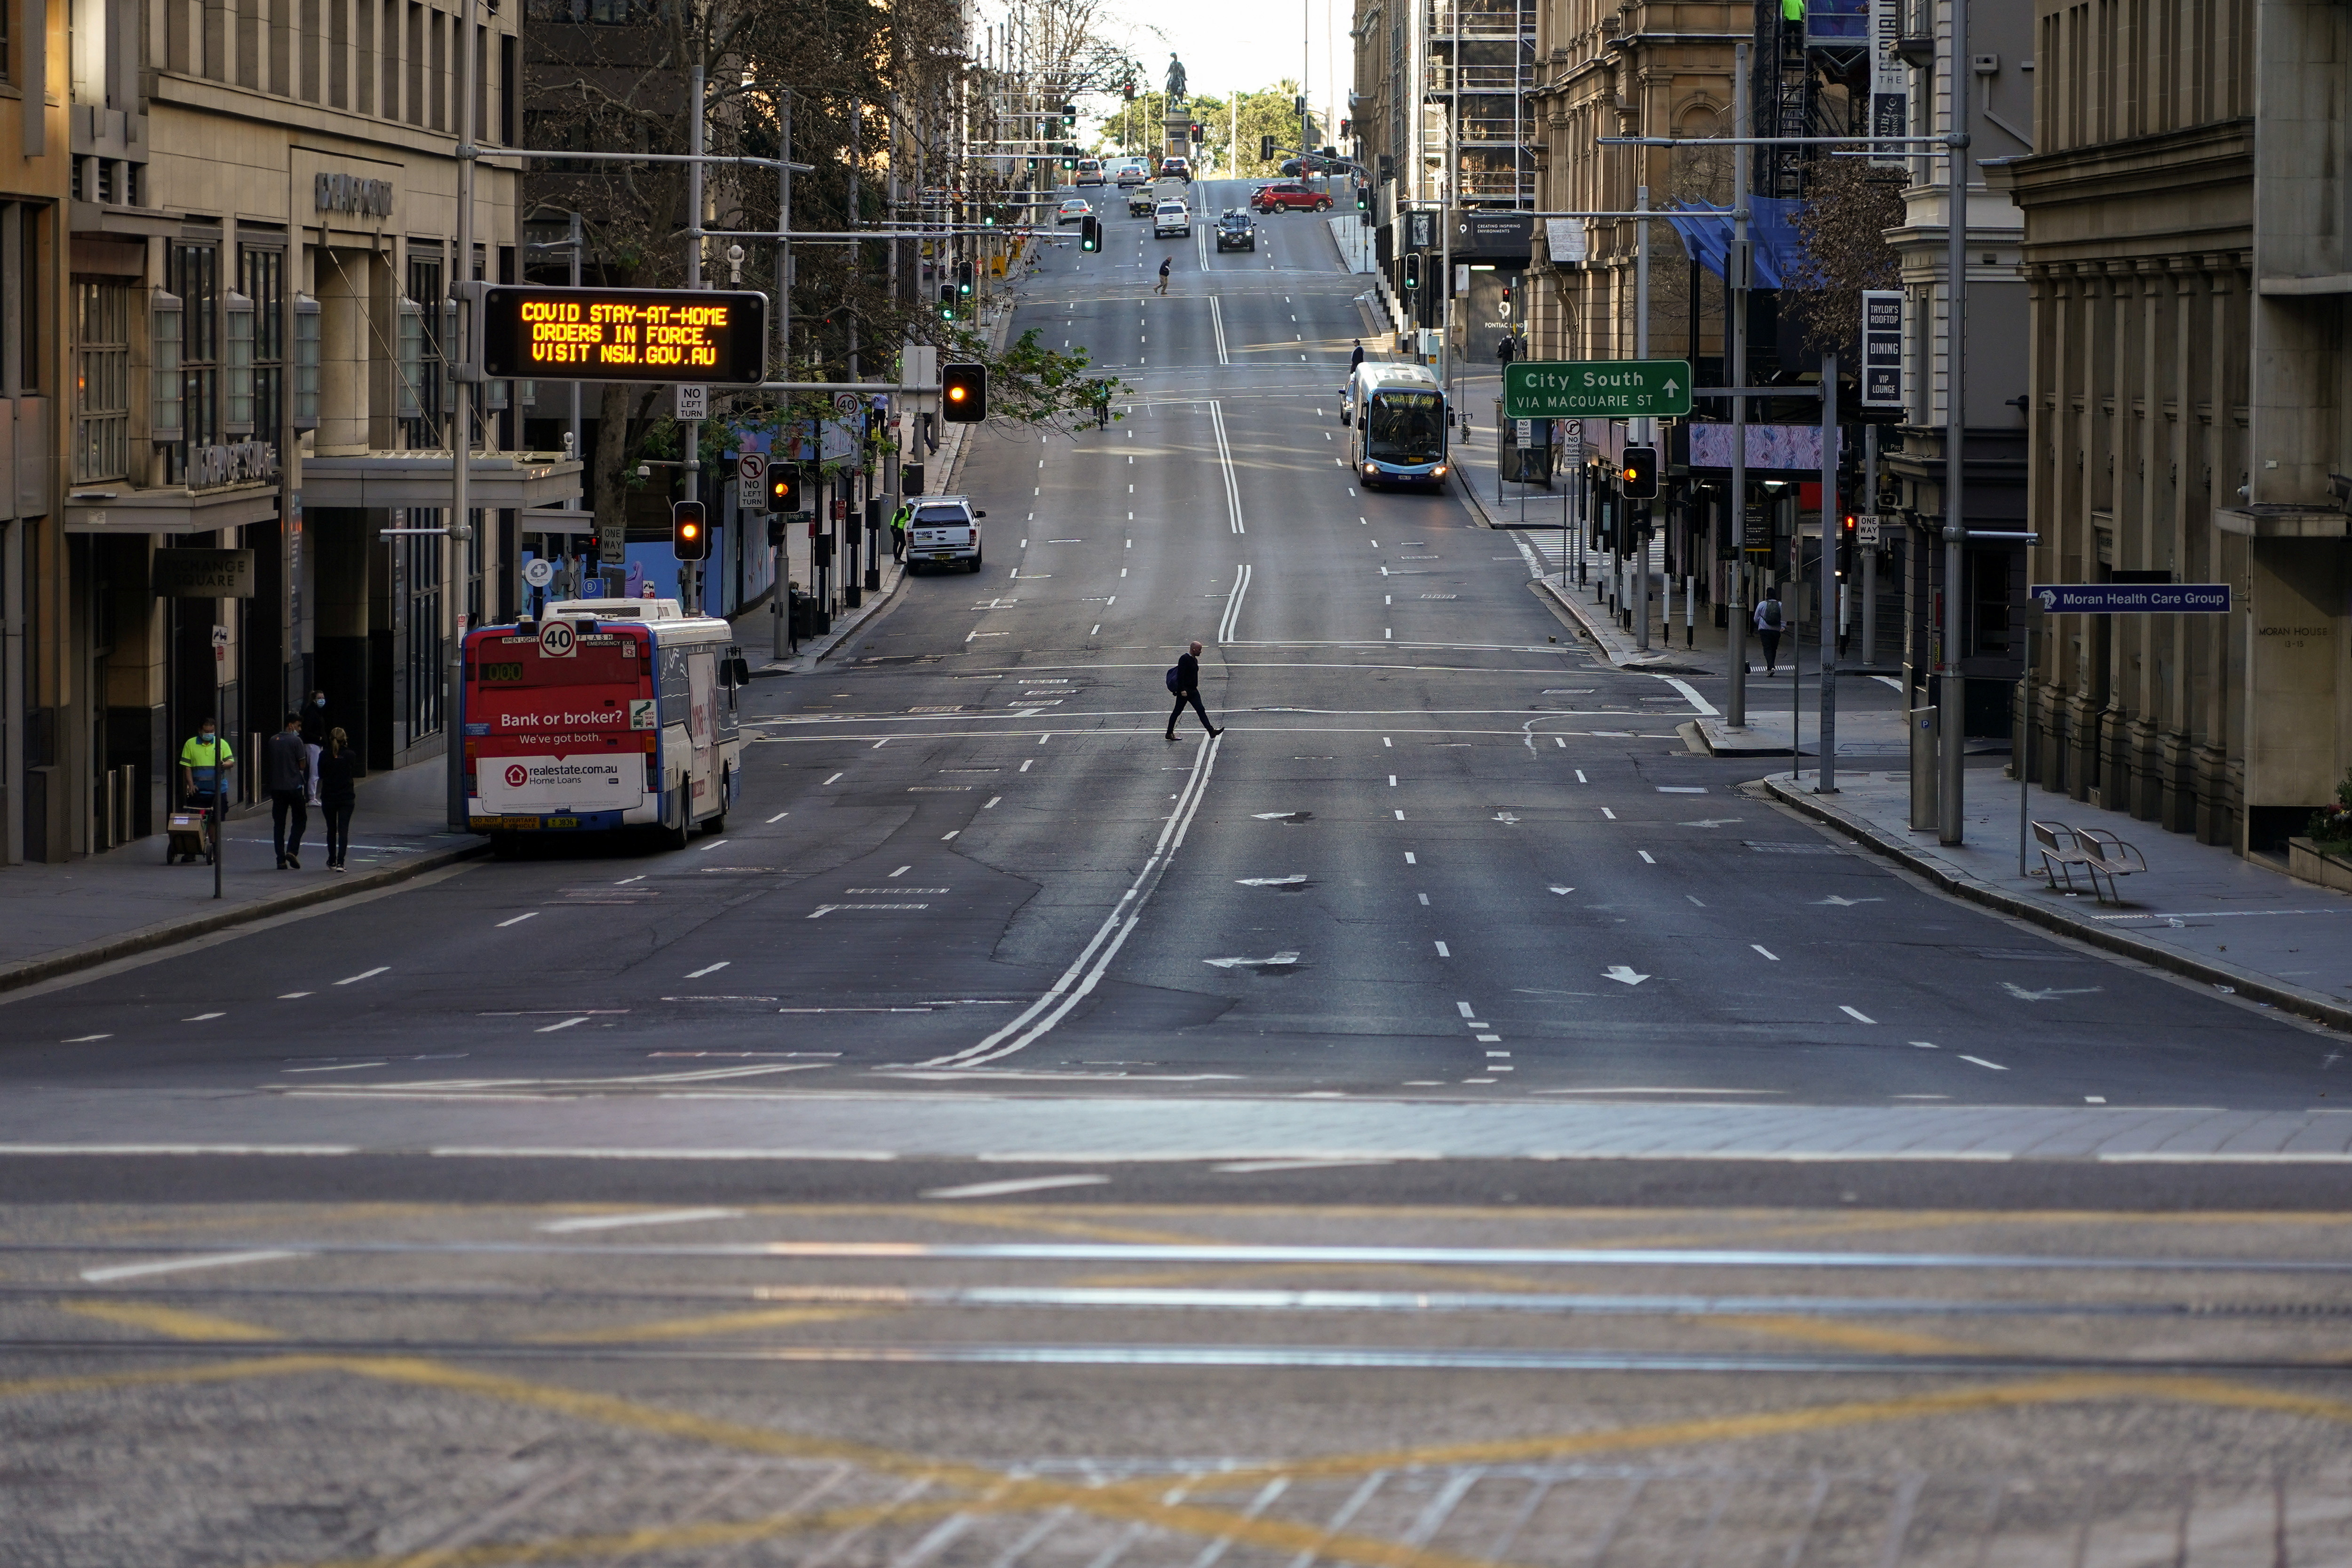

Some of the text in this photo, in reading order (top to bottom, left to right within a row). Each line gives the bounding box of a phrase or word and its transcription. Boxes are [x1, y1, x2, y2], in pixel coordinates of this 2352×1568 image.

[521, 302, 728, 326] COVID STAY-AT-HOME
[1870, 305, 1899, 314] TAYLOR'S
[1870, 315, 1898, 324] ROOFTOP
[532, 323, 712, 345] ORDERS IN FORCE.
[532, 342, 716, 365] VISIT NSW.GOV.AU
[1870, 342, 1898, 354] DINING
[1526, 371, 1644, 390] City South
[1879, 374, 1889, 383] VIP
[684, 388, 700, 398] NO
[1872, 385, 1895, 394] LOUNGE
[839, 400, 854, 410] 40
[1516, 395, 1653, 408] VIA MACQUARIE ST
[604, 529, 620, 538] ONE
[164, 560, 245, 573] XCHANGE
[2063, 592, 2225, 606] Moran Health Care Group
[2294, 627, 2328, 636] HOUSE
[544, 630, 571, 648] 40
[501, 710, 623, 727] Bank or broker?
[519, 732, 602, 745] We've got both.
[529, 765, 617, 776] realestate.com.au
